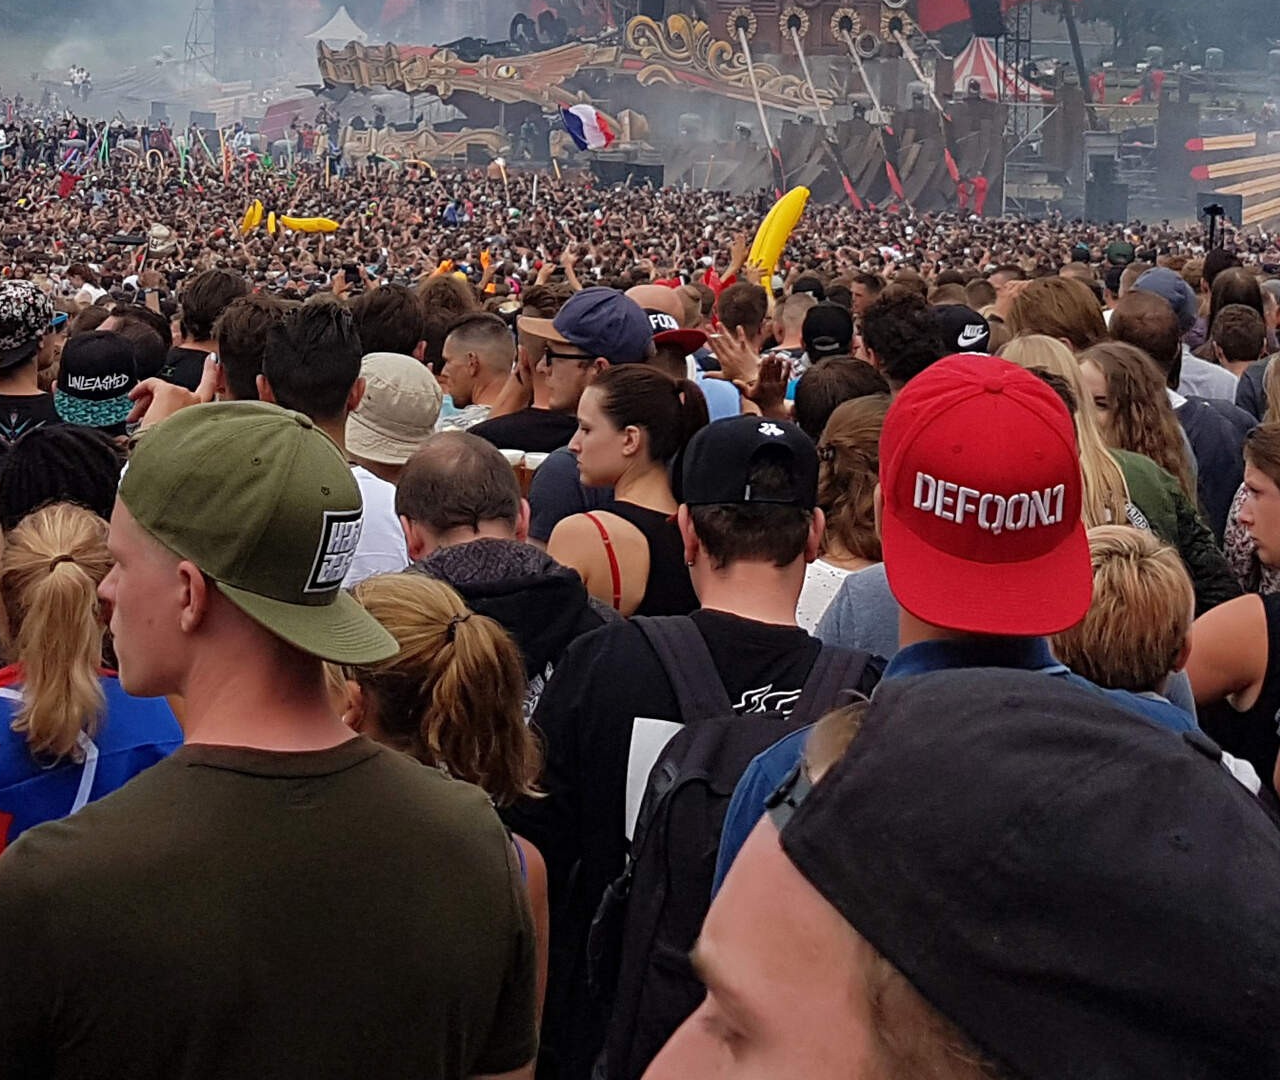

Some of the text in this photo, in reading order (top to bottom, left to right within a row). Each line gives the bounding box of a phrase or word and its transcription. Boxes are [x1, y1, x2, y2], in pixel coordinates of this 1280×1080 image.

[963, 324, 984, 337] NIKE
[68, 372, 129, 391] UNLEASHED
[913, 471, 1065, 535] DEFQON.1
